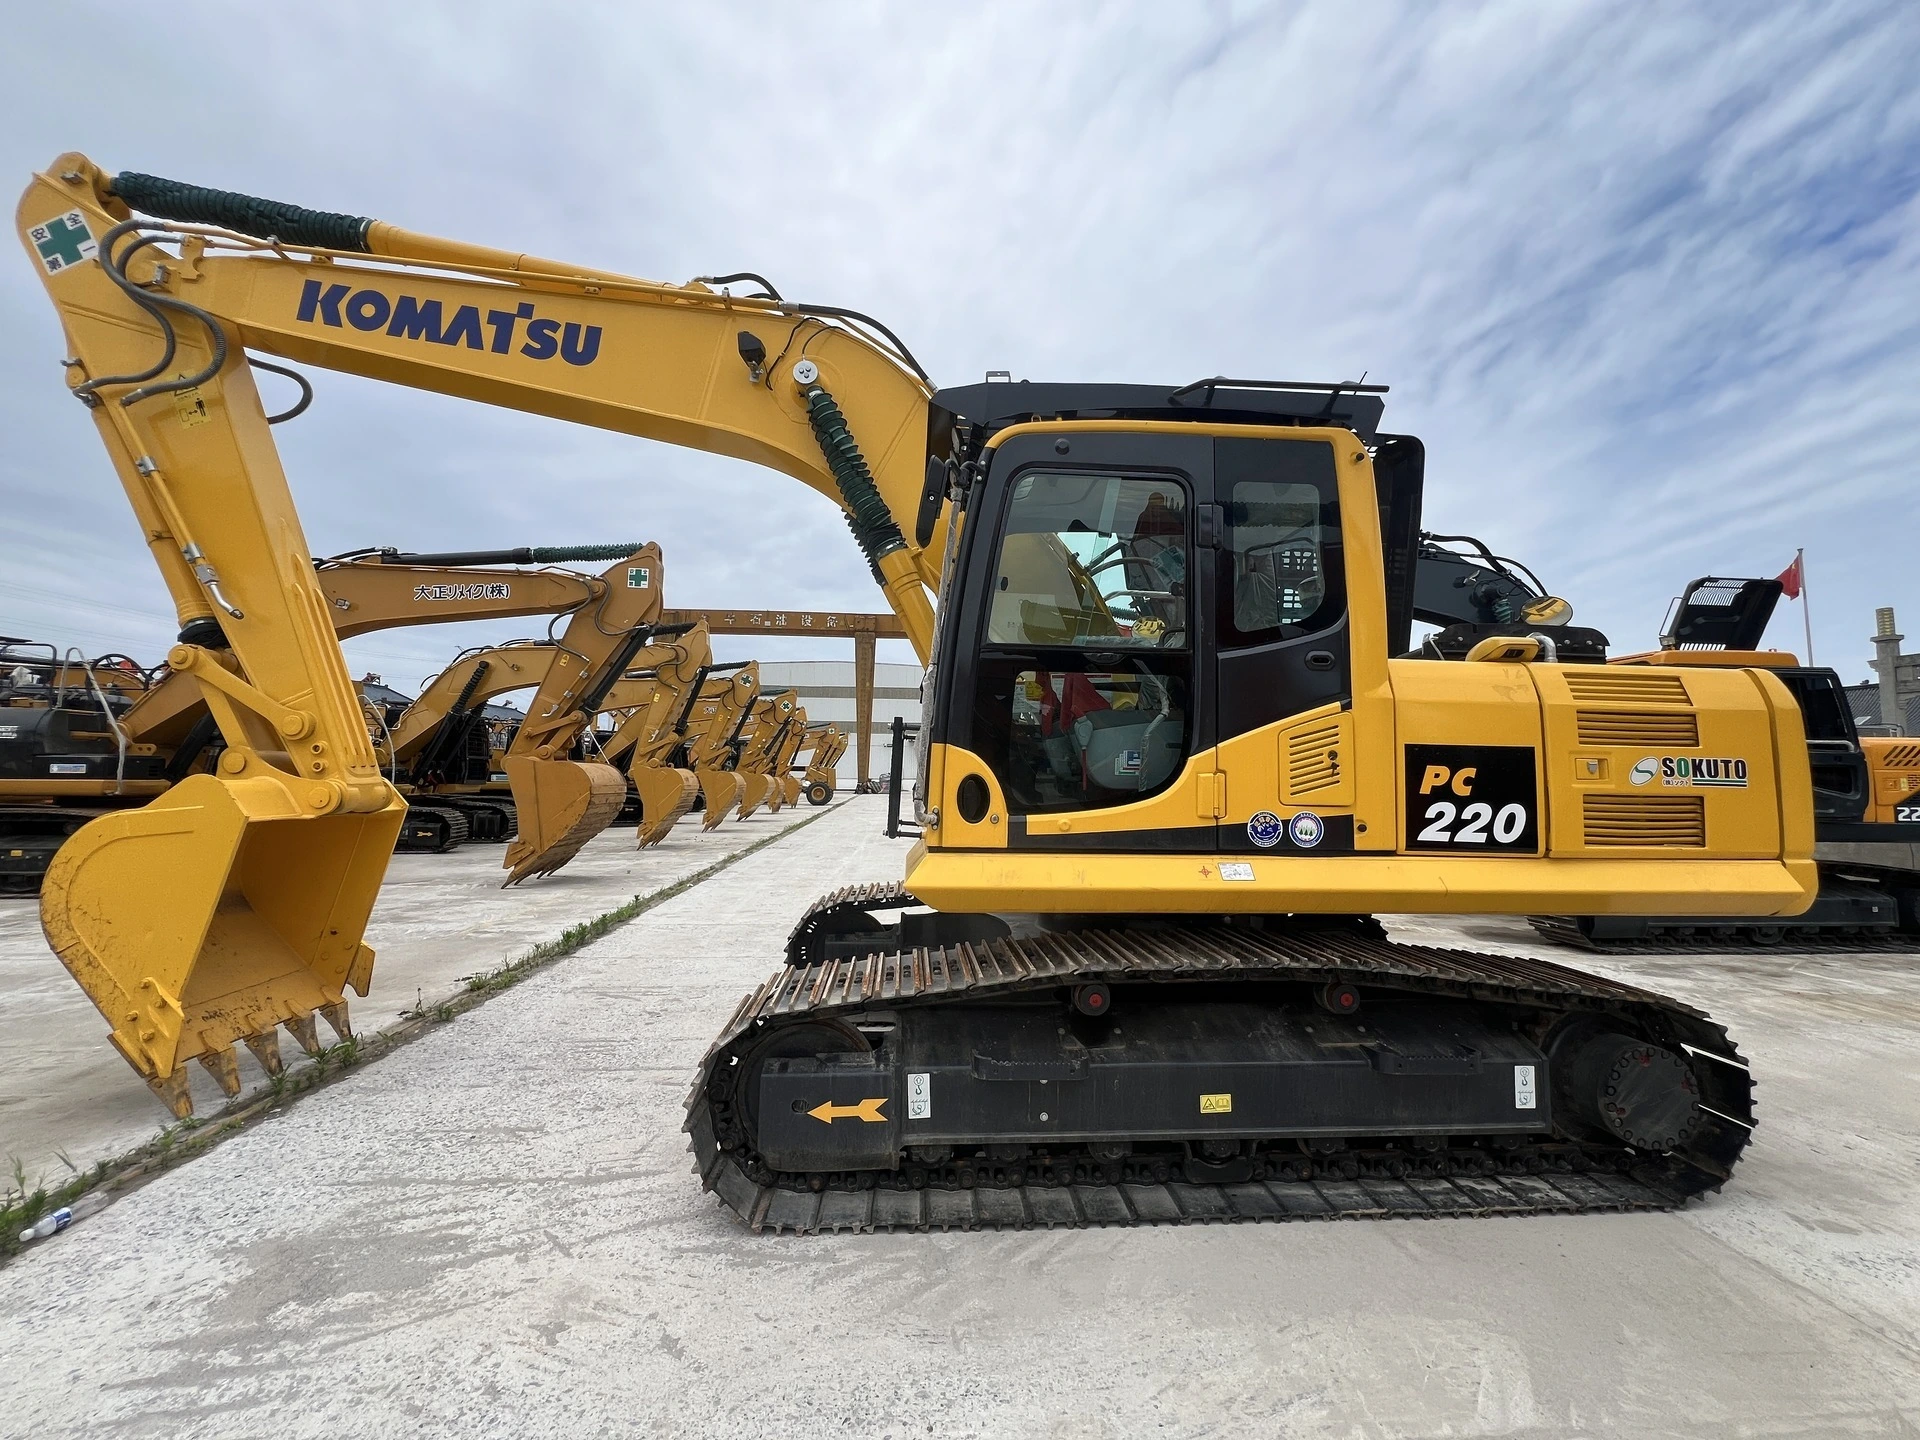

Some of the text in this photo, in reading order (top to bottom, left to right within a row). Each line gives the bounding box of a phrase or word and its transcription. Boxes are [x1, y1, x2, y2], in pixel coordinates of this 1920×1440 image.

[296, 279, 603, 366] KOMATSU
[1419, 765, 1477, 796] PC
[1661, 757, 1747, 779] SOKUTO
[1417, 801, 1527, 844] 220
